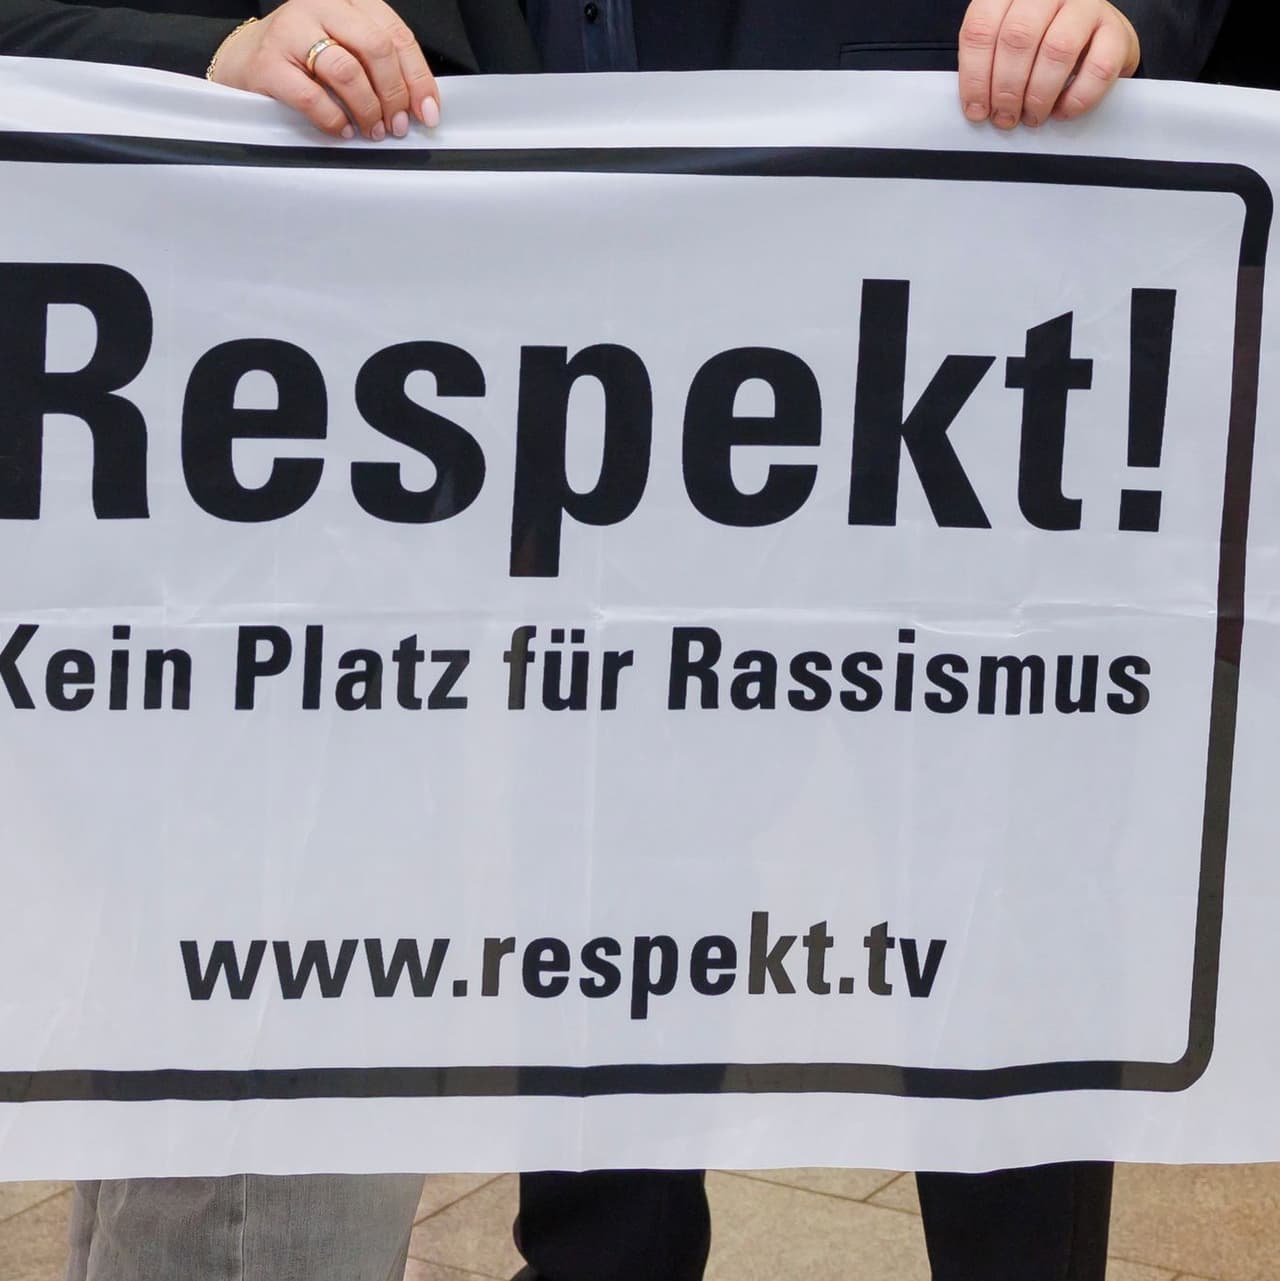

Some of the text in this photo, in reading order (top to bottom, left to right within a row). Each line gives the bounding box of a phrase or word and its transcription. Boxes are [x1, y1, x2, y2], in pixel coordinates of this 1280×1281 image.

[235, 625, 470, 711] Platz
[503, 626, 633, 711] für
[668, 627, 1151, 715] Rassismus
[180, 912, 947, 1019] www.respekt.tv
